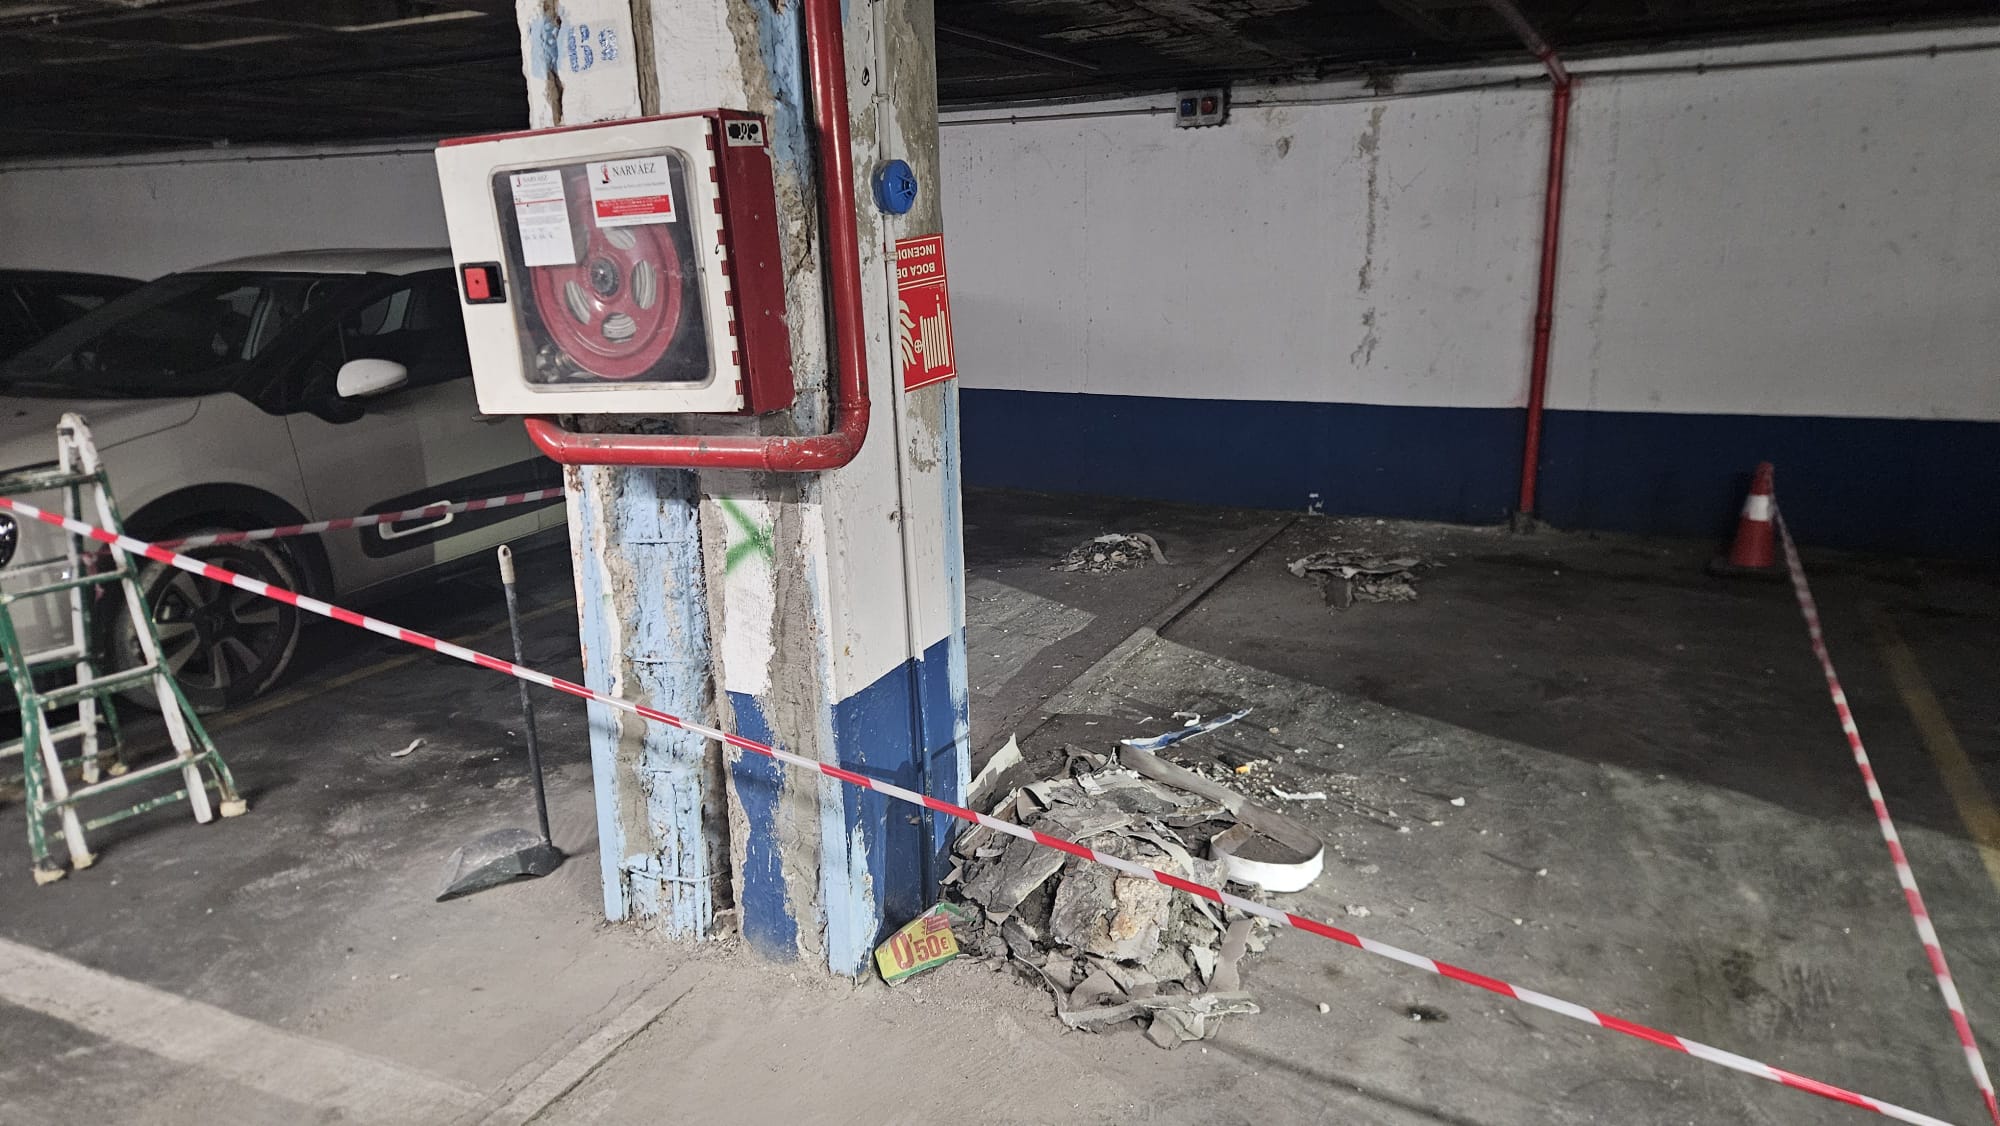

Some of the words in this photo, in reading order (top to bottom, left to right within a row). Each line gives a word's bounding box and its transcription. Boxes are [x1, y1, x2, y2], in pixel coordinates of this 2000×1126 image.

[897, 243, 936, 260] INCENDI
[896, 267, 909, 280] DE
[909, 261, 936, 277] BOCA
